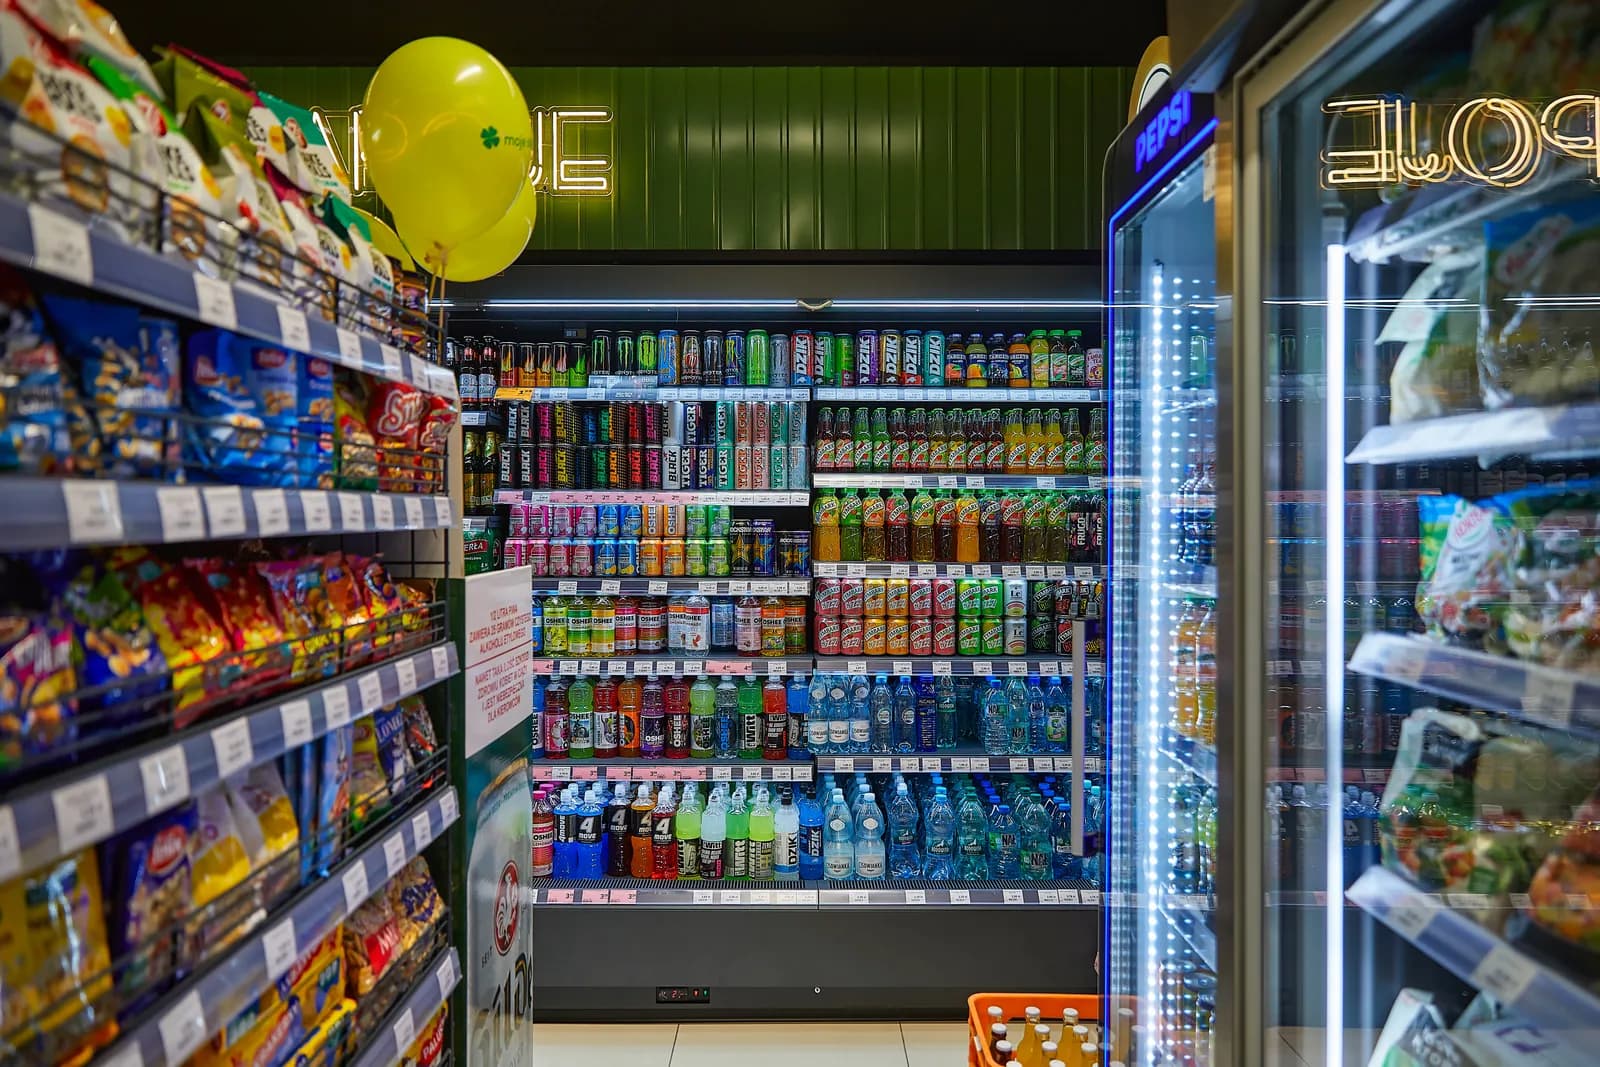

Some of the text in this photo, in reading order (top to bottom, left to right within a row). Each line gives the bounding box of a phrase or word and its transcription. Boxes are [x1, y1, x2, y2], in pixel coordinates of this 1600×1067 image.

[1135, 91, 1191, 173] PEPSI
[796, 336, 808, 374] DZIK
[815, 337, 824, 376] DZIK
[860, 336, 870, 375] DZIK
[886, 337, 896, 375] DZIK
[905, 337, 916, 374] DZIK
[930, 336, 940, 376] DZIK
[509, 406, 518, 438] BLACK
[521, 404, 530, 438] BLACK
[688, 404, 696, 444] TIGER
[718, 404, 726, 442] TIGER
[738, 402, 746, 442] TIGER
[502, 450, 510, 482] BLACK
[522, 450, 530, 482] BLACK
[558, 450, 566, 482] BLACK
[632, 450, 641, 482] BLACK
[668, 450, 677, 482] BLACK
[682, 449, 690, 487] TIGER
[700, 449, 708, 487] TIGER
[720, 450, 728, 487] TIGER
[738, 449, 747, 488] TIGER
[580, 817, 594, 834] 4
[612, 808, 626, 825] 4
[640, 811, 652, 827] 4
[656, 818, 670, 834] 4
[788, 836, 798, 865] DZIK
[811, 829, 820, 857] DZIK
